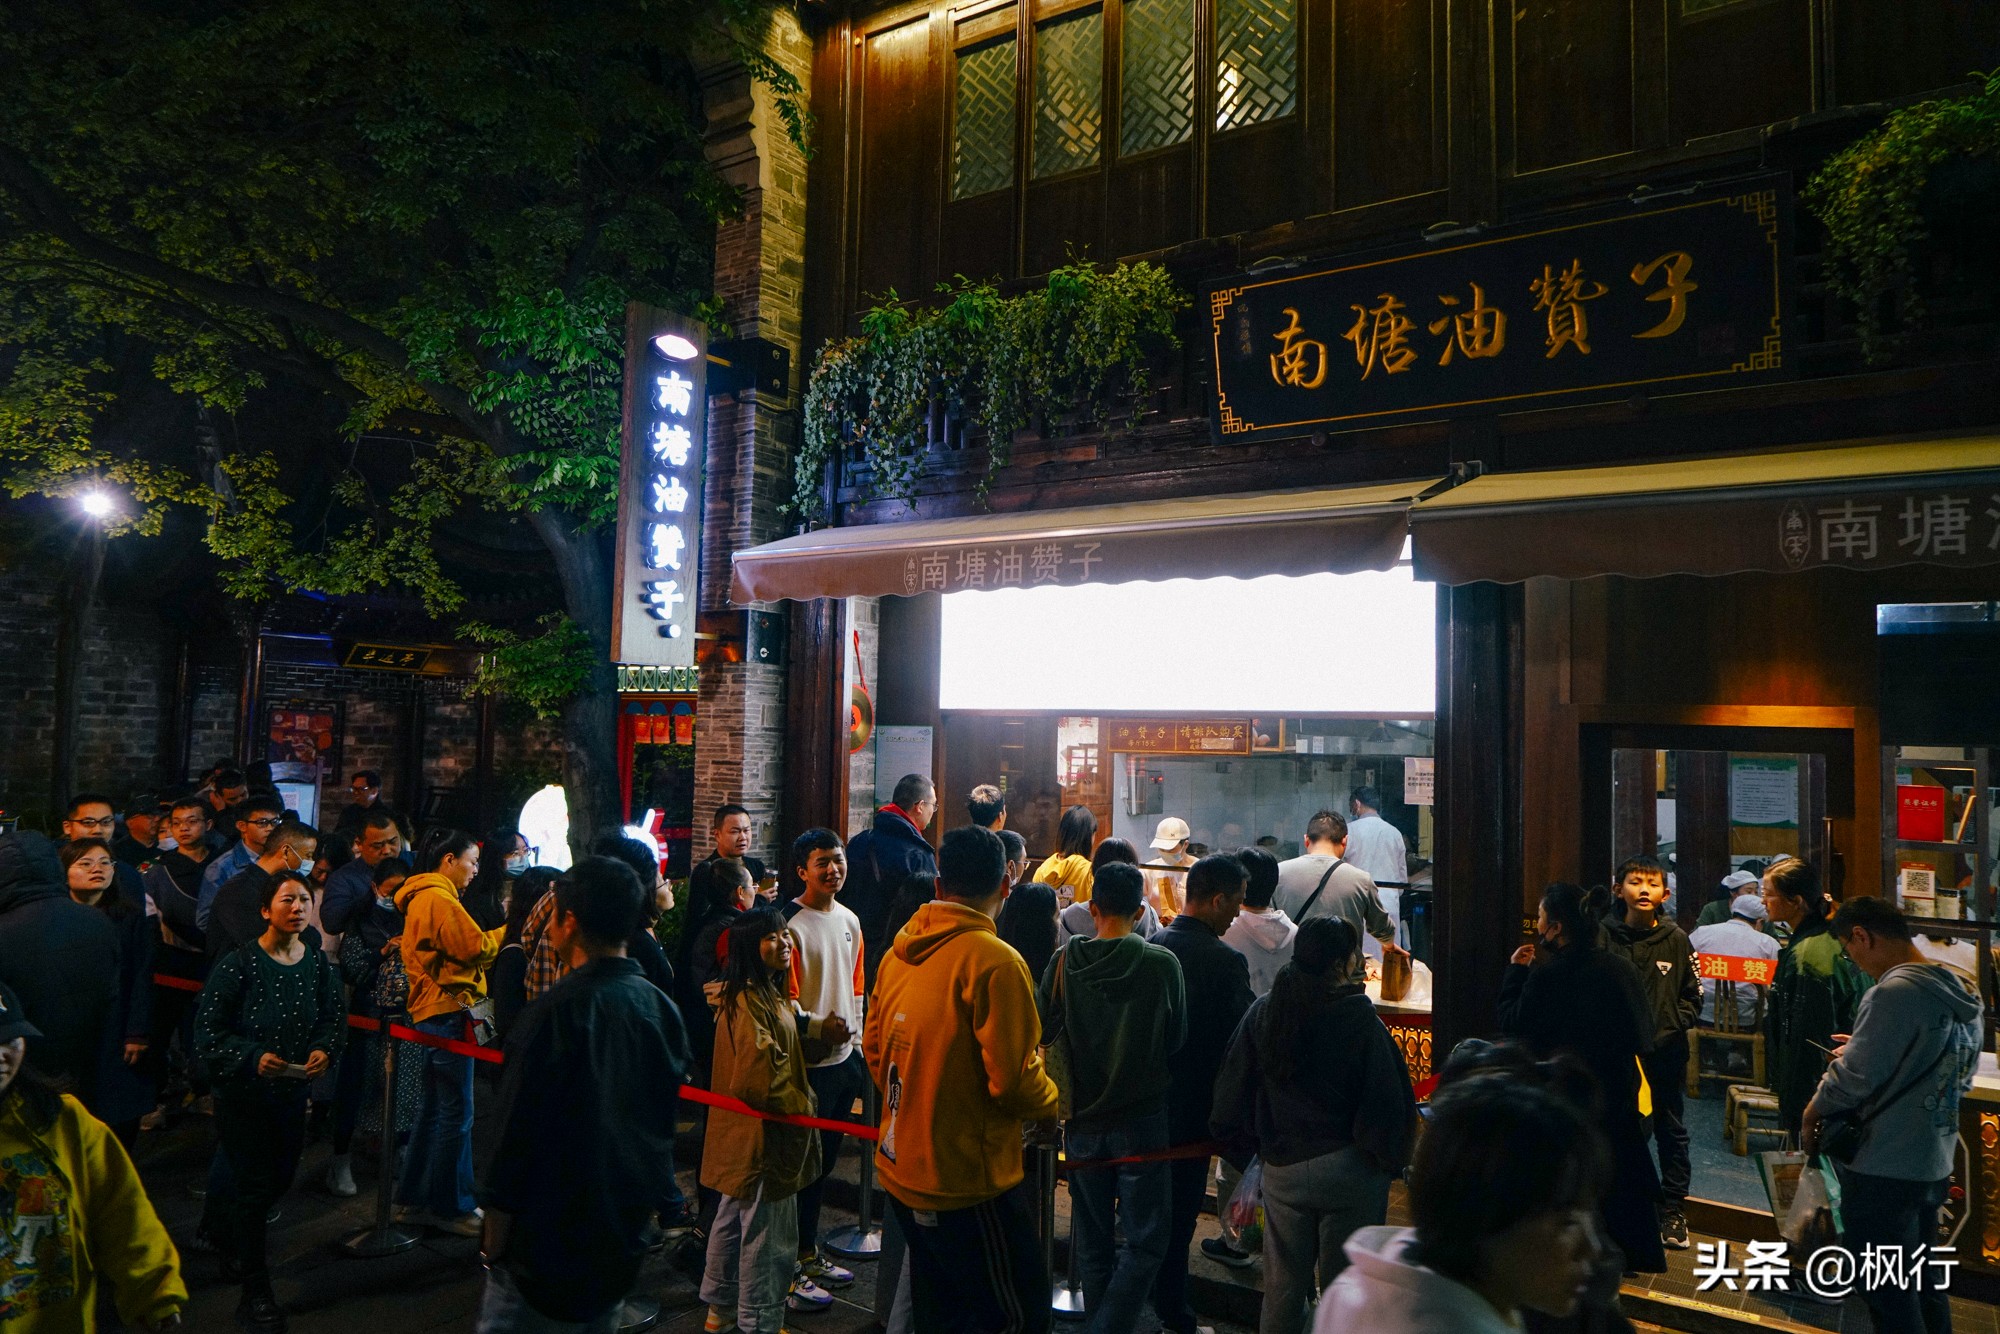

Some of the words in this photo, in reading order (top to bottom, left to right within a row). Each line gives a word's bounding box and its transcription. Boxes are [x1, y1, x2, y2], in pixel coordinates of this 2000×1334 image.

[920, 541, 1103, 591] 南塘油赞子
[1180, 724, 1244, 738] 请排队购买
[1704, 956, 1768, 982] 油赞
